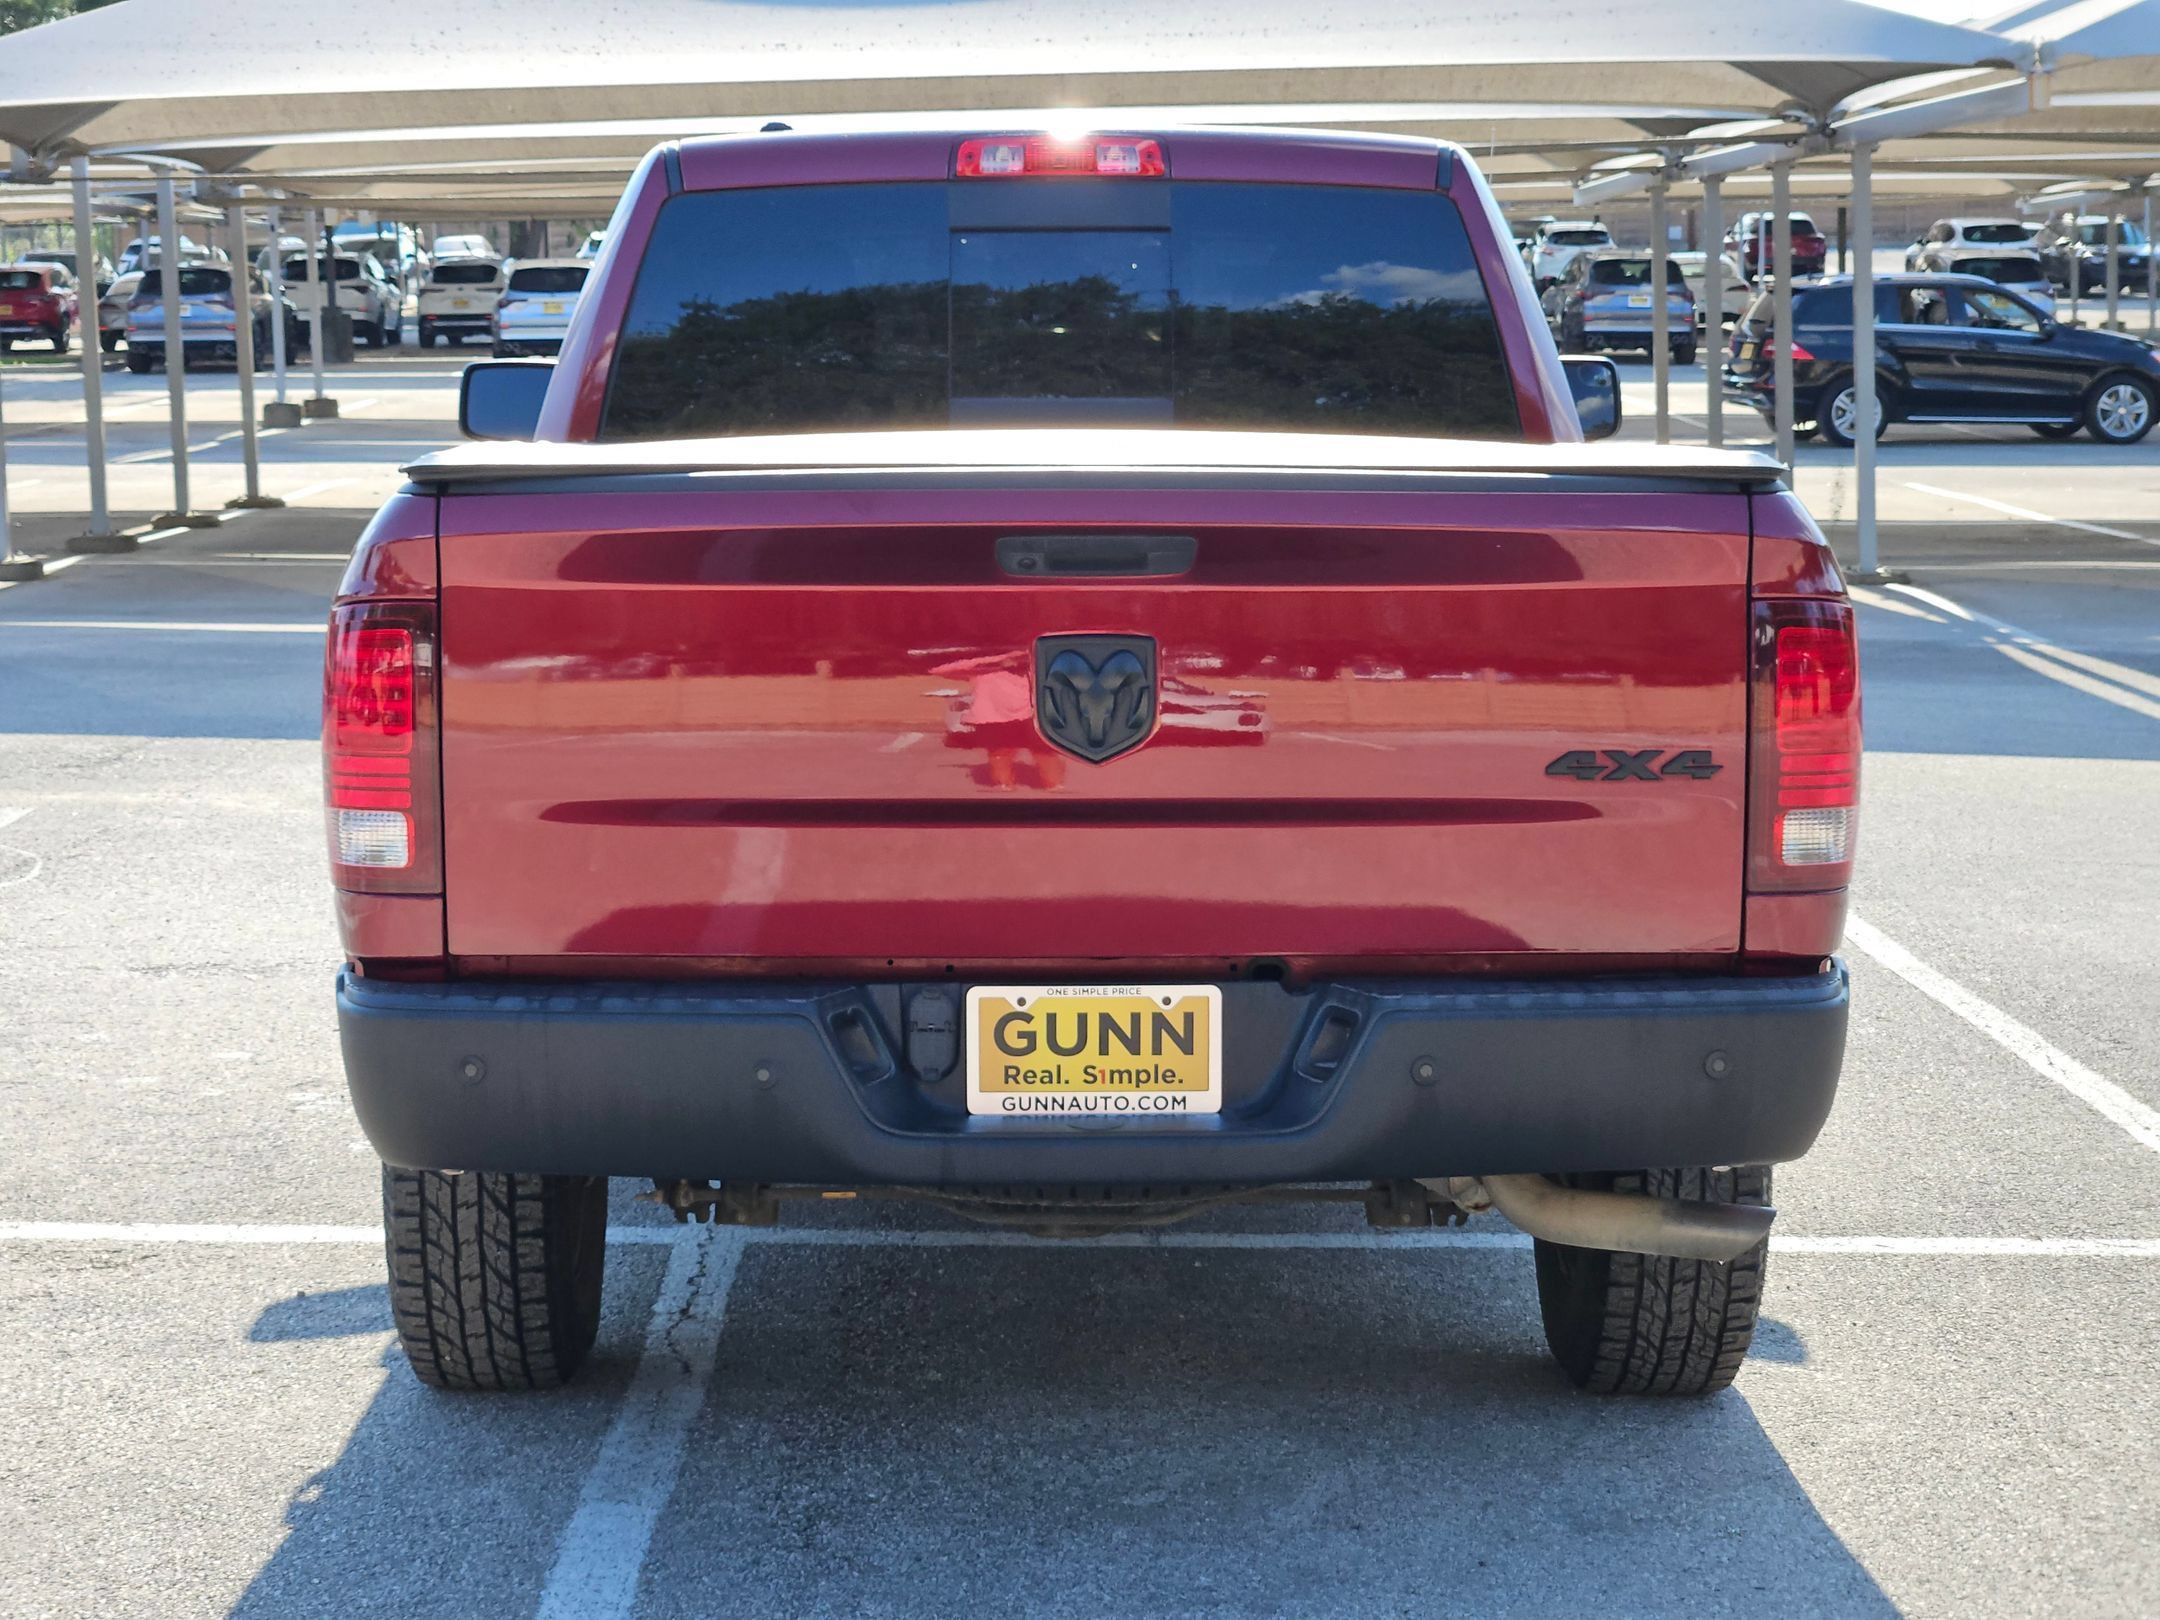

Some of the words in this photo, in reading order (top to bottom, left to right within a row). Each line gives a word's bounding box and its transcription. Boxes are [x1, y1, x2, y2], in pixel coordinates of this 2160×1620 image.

[1545, 750, 1724, 781] 4X4
[1047, 988, 1068, 996] ONE
[1072, 987, 1108, 996] SIMPLE
[1112, 987, 1142, 995] PRICE
[993, 1011, 1194, 1057] GUNN
[1003, 1065, 1069, 1085] Real.
[1002, 1096, 1187, 1111] GUNNAUTO.COM
